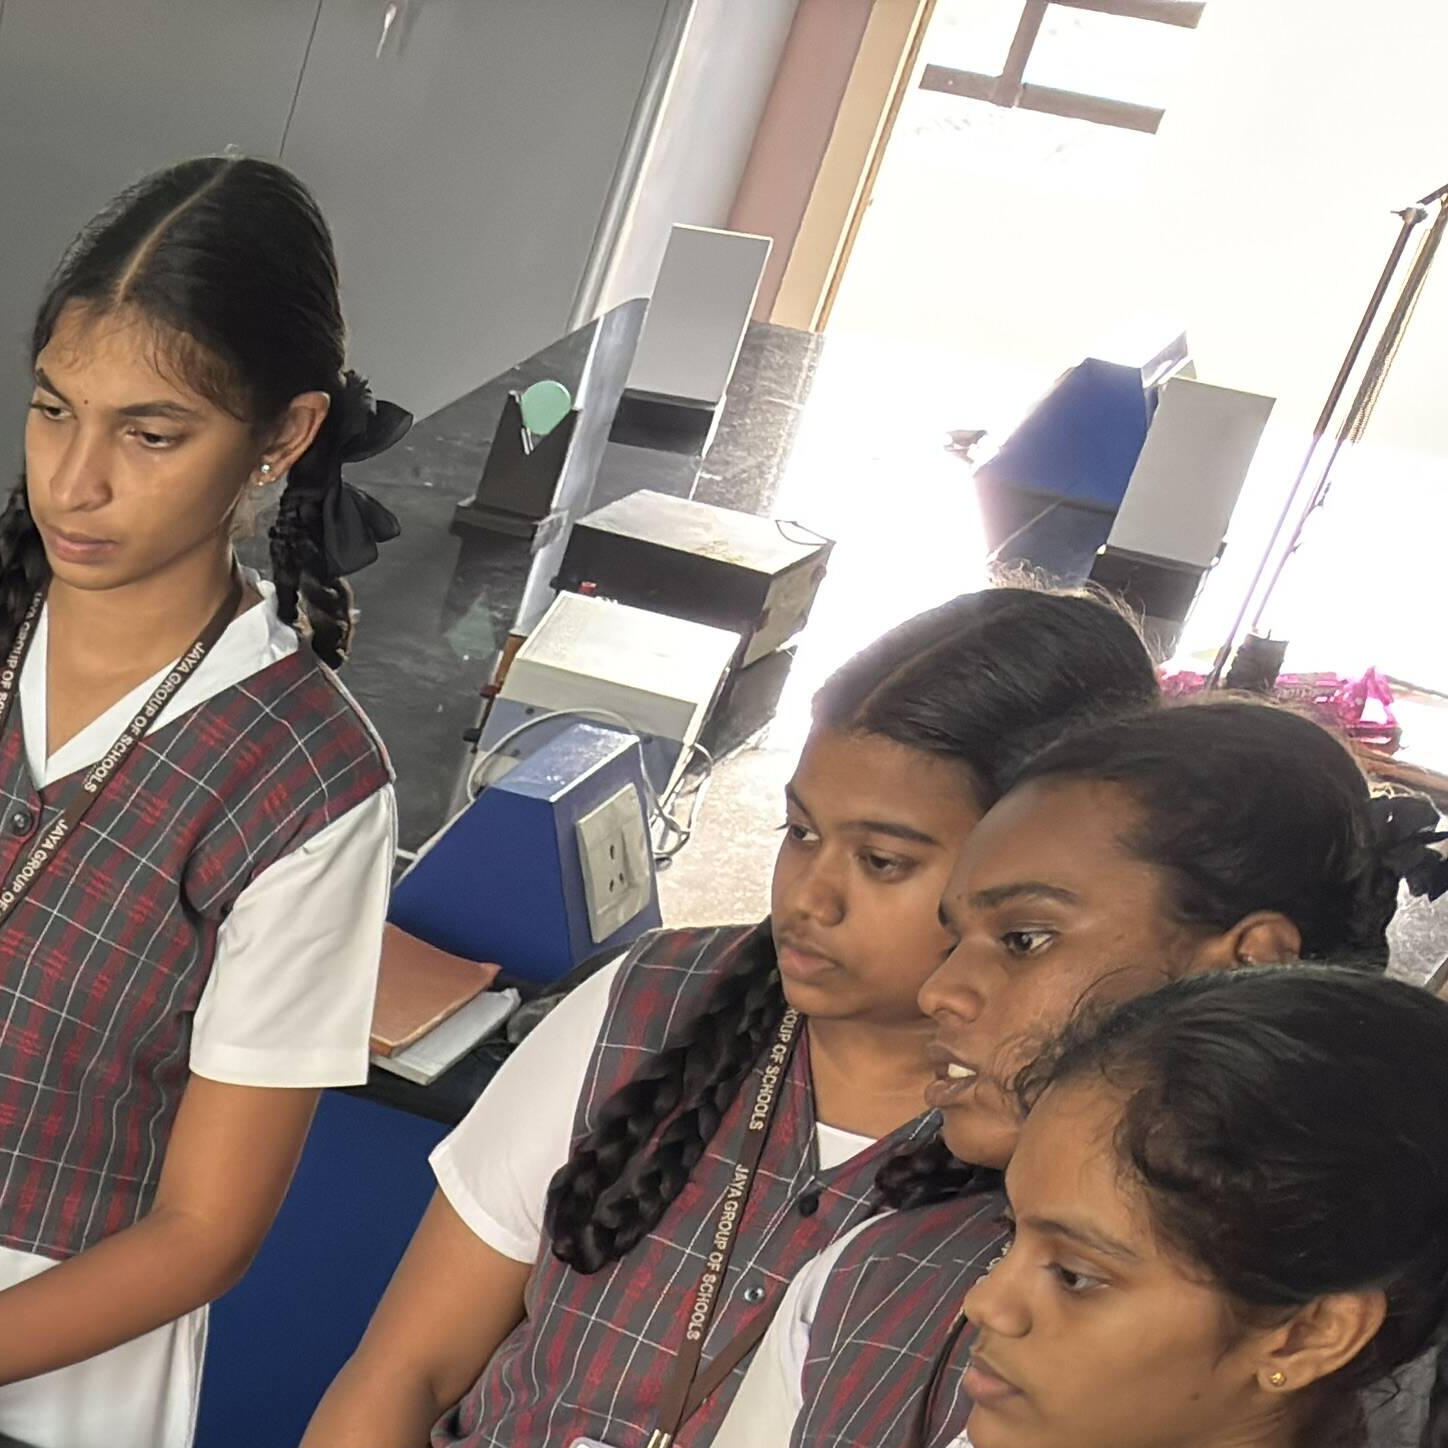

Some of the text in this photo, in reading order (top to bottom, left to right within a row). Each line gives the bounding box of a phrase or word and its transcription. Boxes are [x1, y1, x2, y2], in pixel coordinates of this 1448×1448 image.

[1, 669, 16, 694] OF
[84, 641, 205, 794] JAYA GROUP OF SCHOOLS
[44, 818, 69, 854] JAYA
[14, 850, 51, 901] GROUP
[769, 1039, 787, 1067] OF
[748, 1065, 782, 1131] SCHOOLS
[686, 1163, 751, 1342] JAYA GROUP OF SCHOOLS
